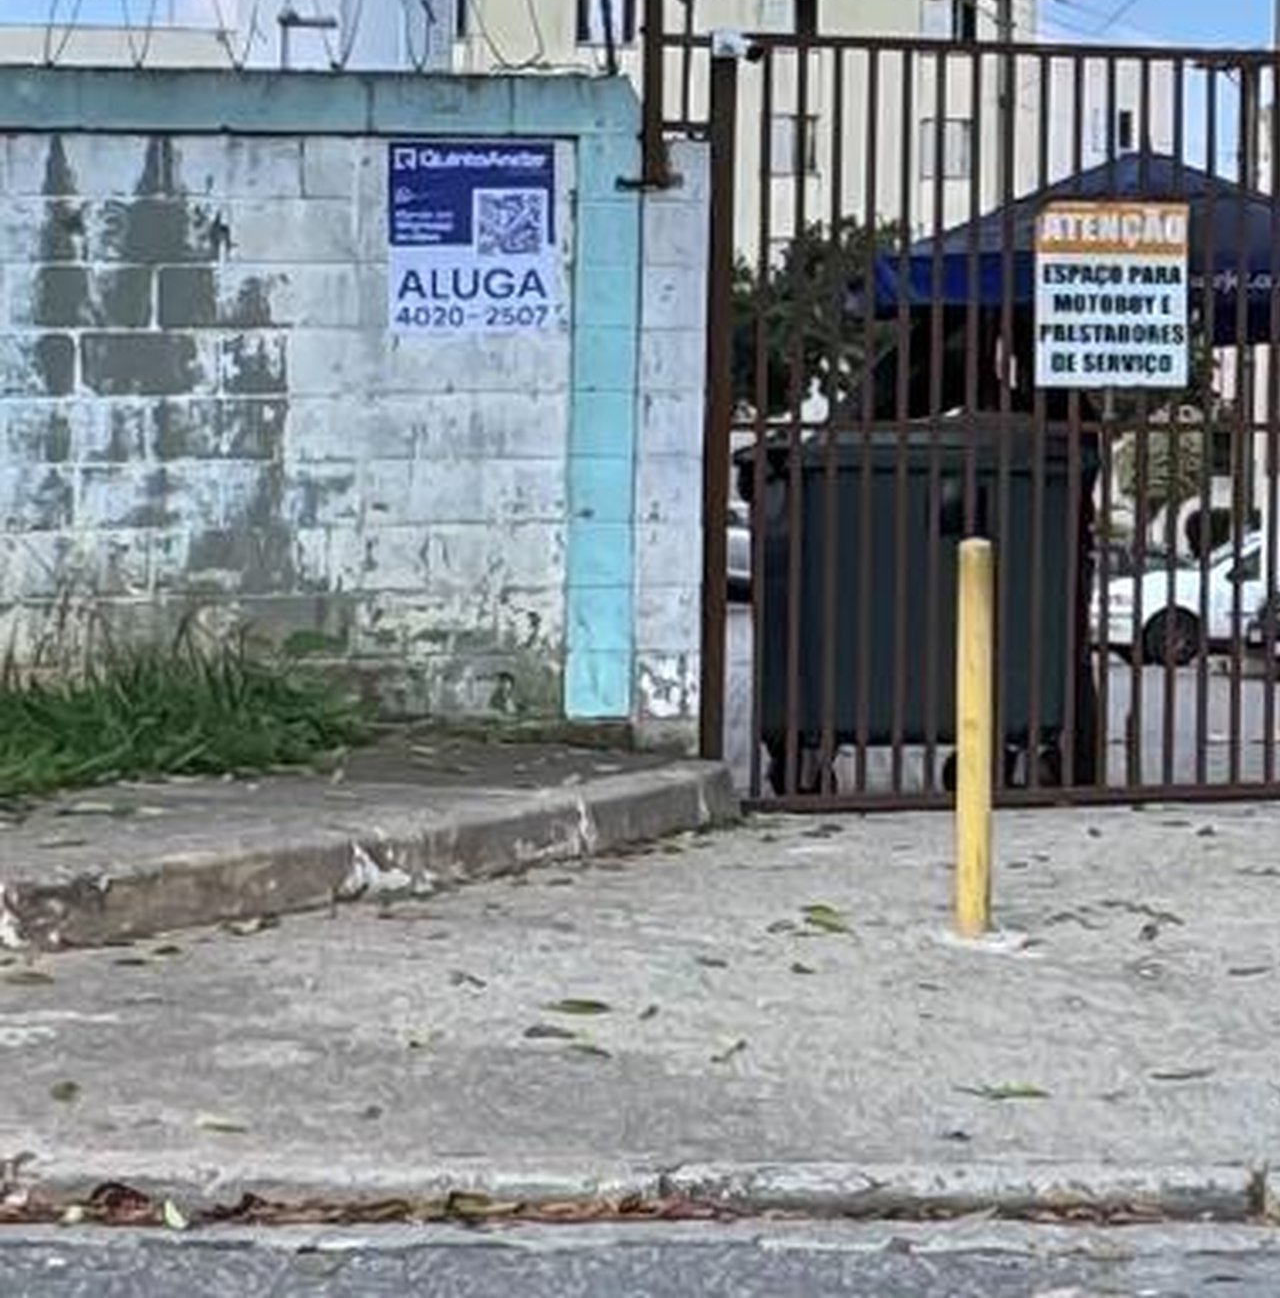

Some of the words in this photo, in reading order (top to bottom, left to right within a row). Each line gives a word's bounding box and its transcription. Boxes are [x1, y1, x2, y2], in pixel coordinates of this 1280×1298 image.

[1043, 211, 1186, 247] ATENÇÃO
[397, 267, 547, 300] ALUGA
[1043, 263, 1123, 286] ESPAÇO
[1129, 265, 1181, 285] PARA
[1053, 293, 1155, 314] MOTOBOY
[1161, 295, 1171, 315] E
[396, 305, 549, 327] 4020-2507
[1040, 324, 1185, 345] PRESTADORES
[1051, 353, 1078, 373] DE
[1083, 353, 1172, 378] SERVIÇO
